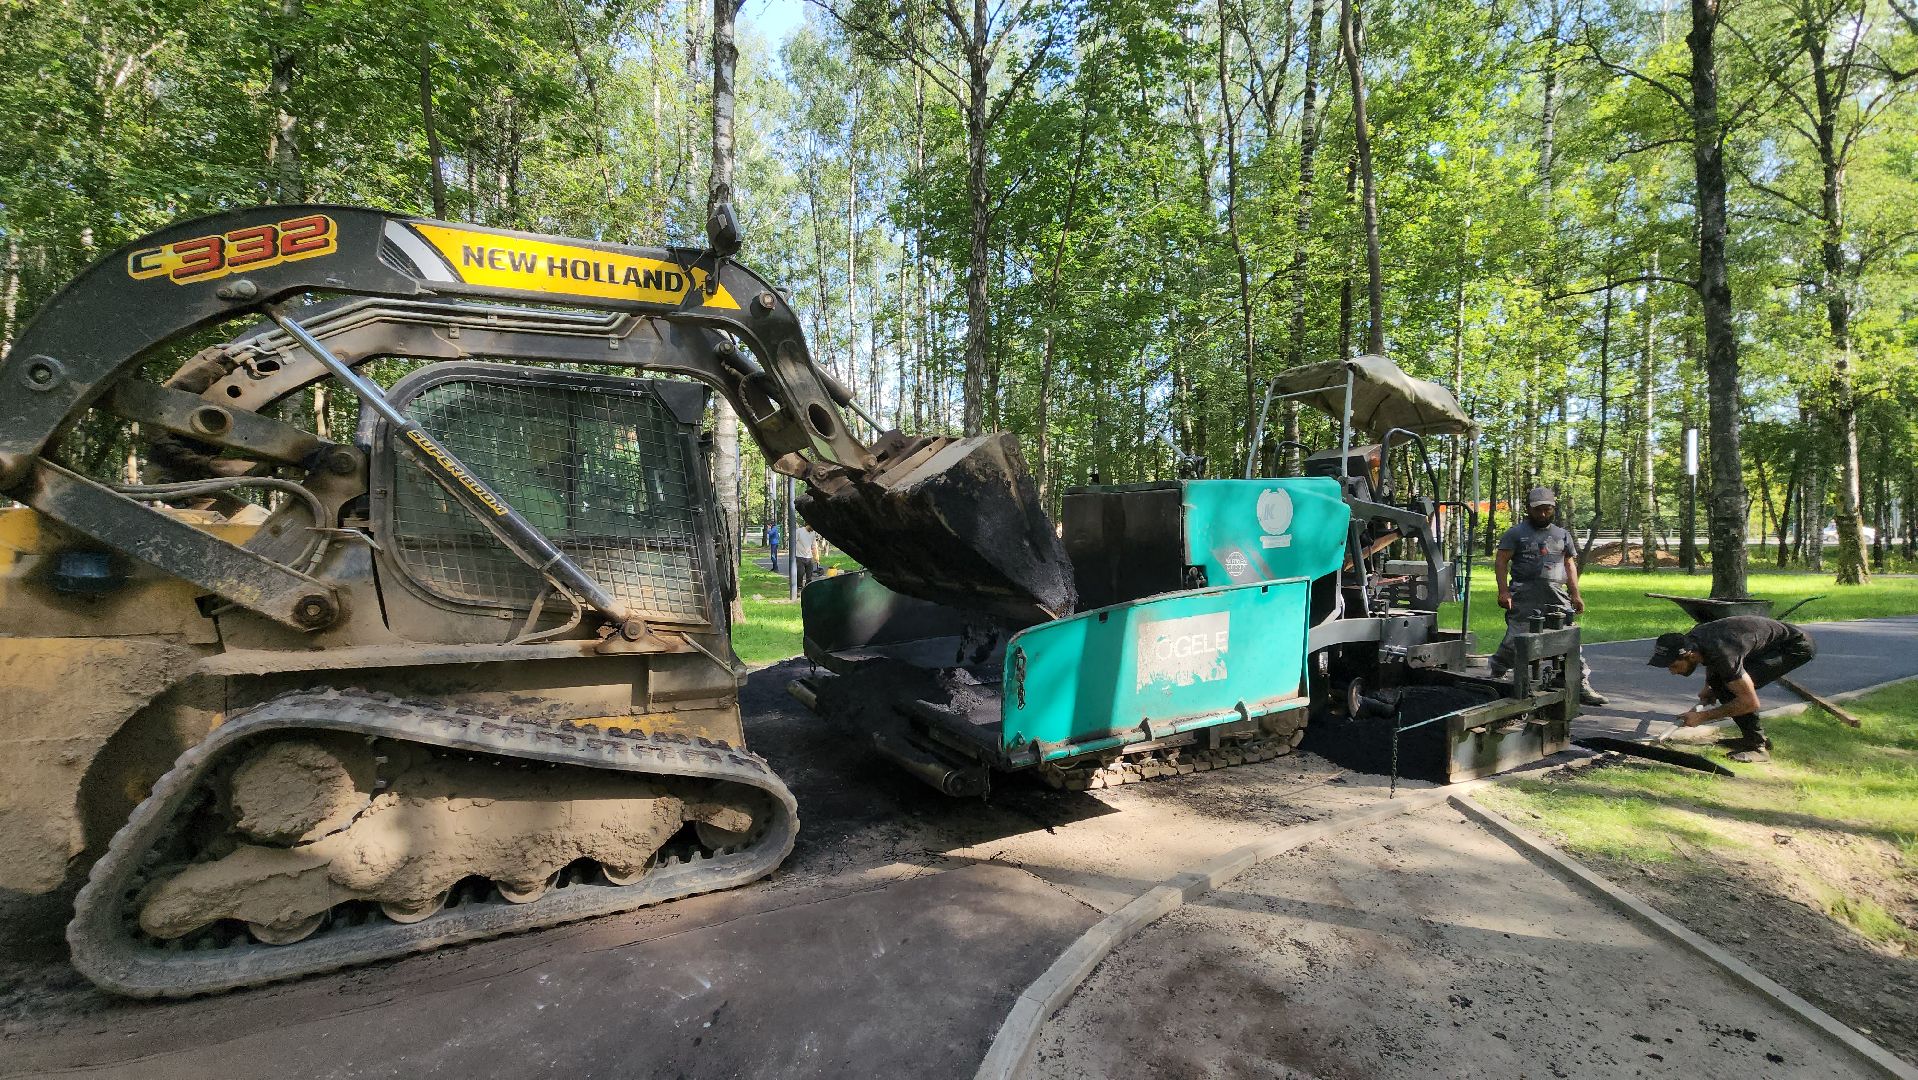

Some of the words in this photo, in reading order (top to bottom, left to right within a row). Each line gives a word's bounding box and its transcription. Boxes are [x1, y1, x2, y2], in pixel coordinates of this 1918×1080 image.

[129, 214, 336, 284] C332
[462, 244, 537, 274] NEW
[547, 256, 684, 293] HOLLAND
